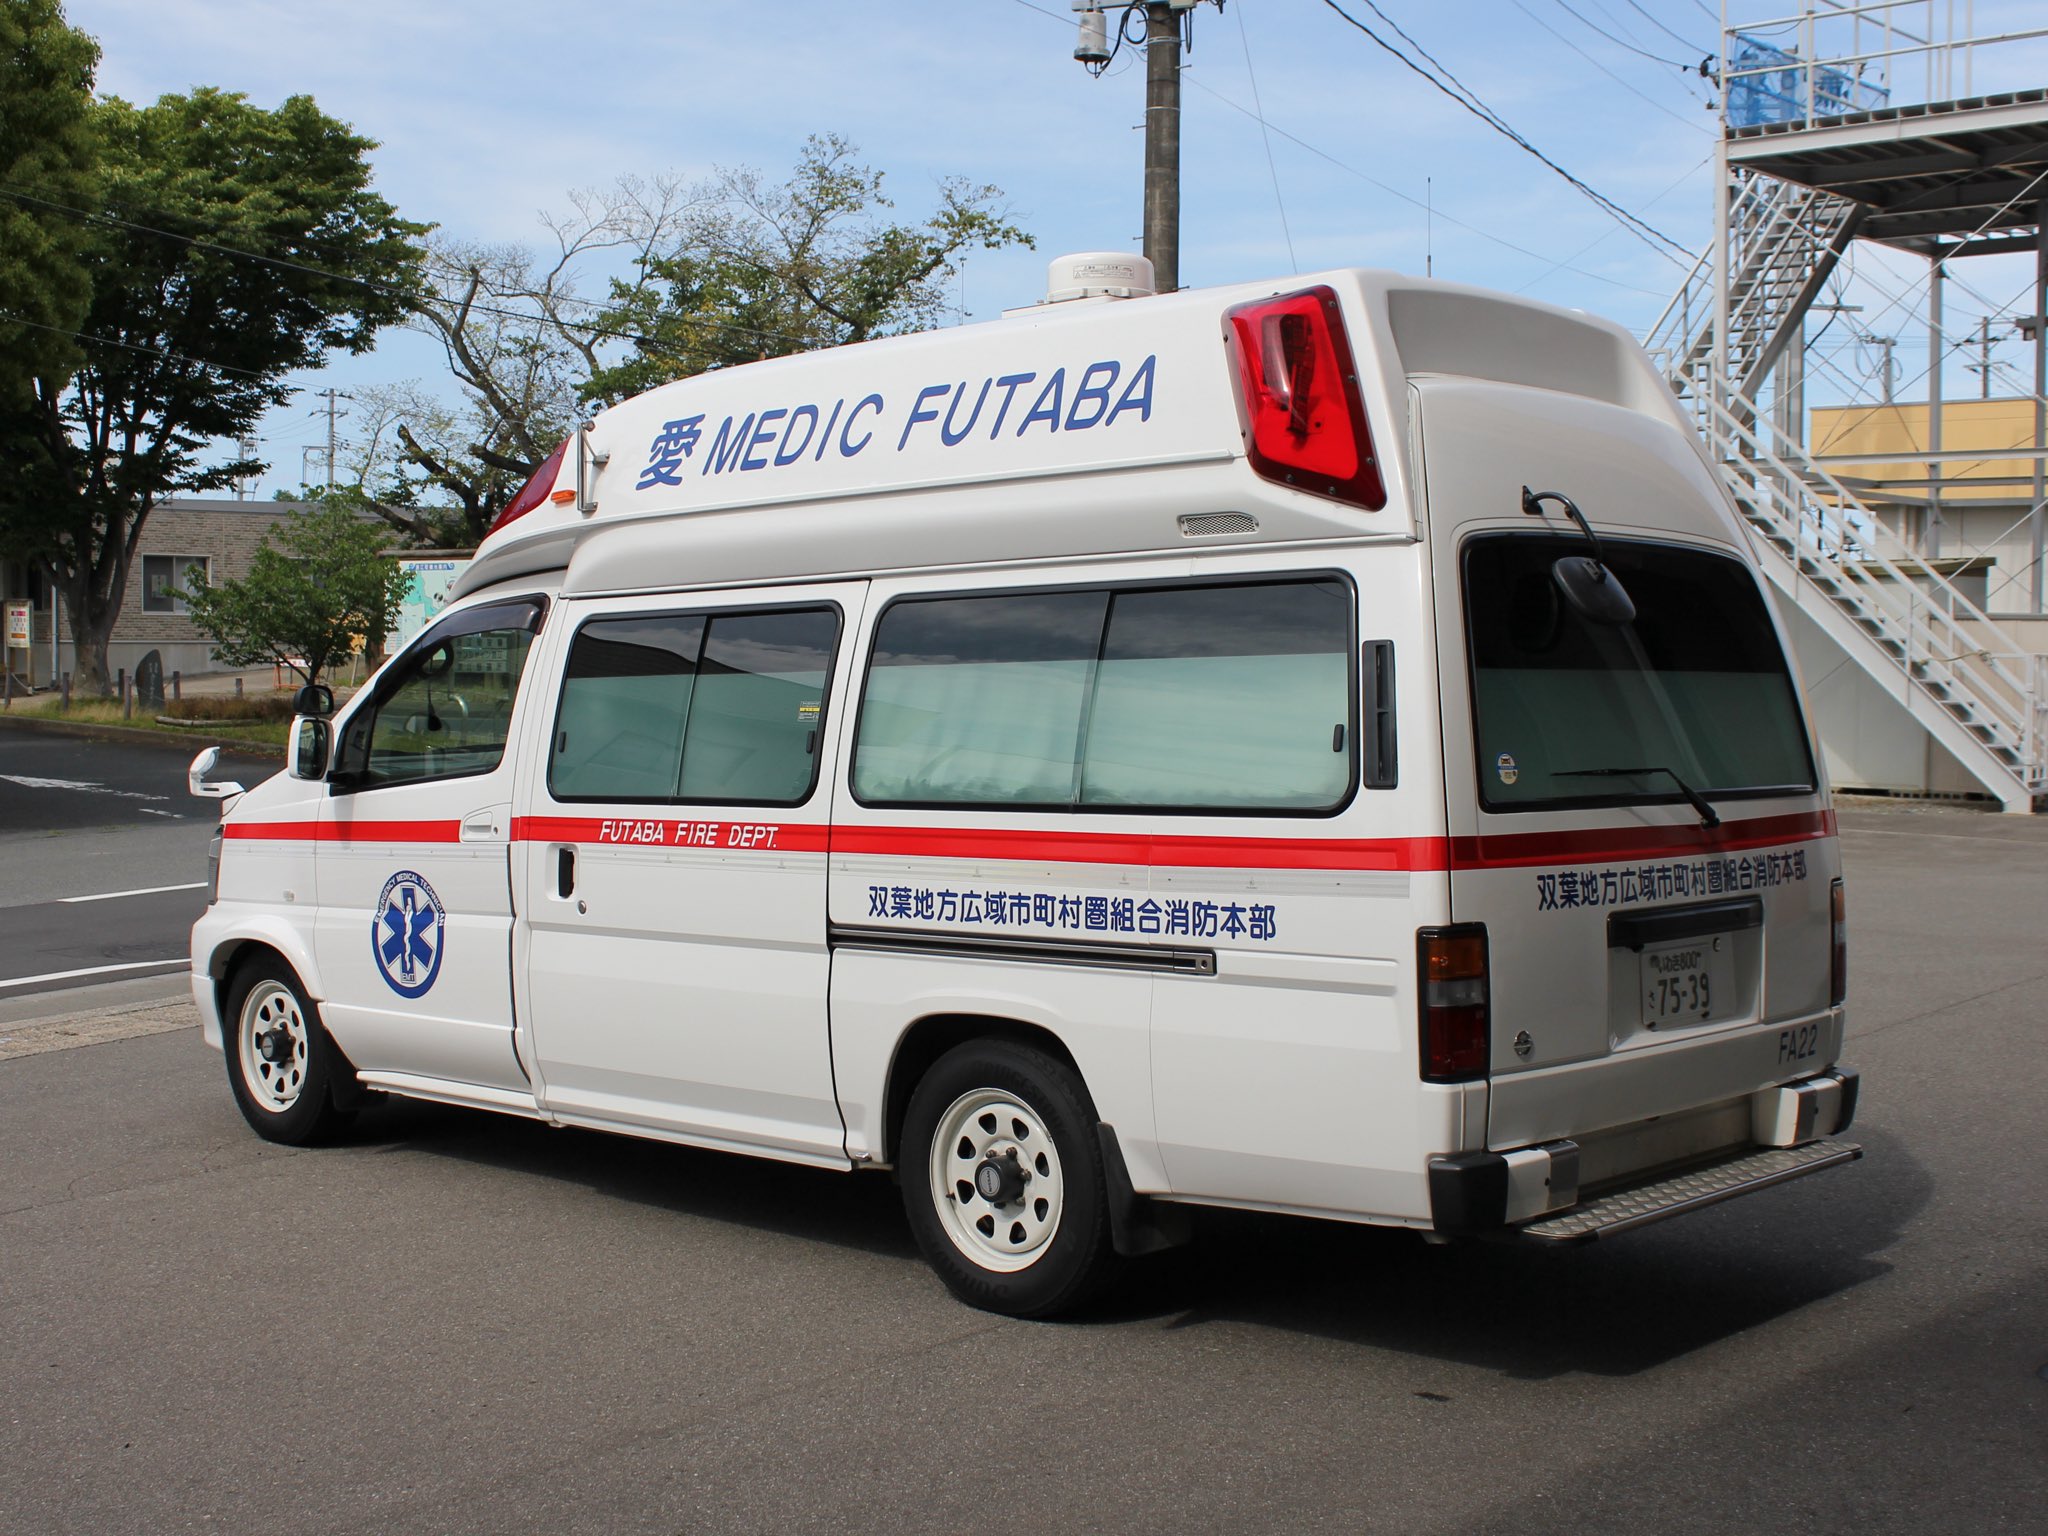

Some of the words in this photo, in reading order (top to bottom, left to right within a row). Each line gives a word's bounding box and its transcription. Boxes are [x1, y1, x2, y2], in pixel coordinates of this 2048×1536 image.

[635, 413, 706, 491] 愛
[702, 393, 884, 476] MEDIC
[897, 354, 1158, 452] FUTABA
[599, 821, 664, 843] FUTABA
[674, 823, 719, 845] FIRE
[727, 826, 779, 848] DEPT.
[396, 873, 419, 884] MEDICAL
[420, 879, 446, 927] TECHNICIAN
[1536, 849, 1807, 912] 双葉地方広域市町村圏組合消防本部
[868, 885, 1277, 941] 双葉地方広域市町村圏組合消防本部
[1657, 972, 1710, 1016] 75-39
[1777, 1023, 1818, 1065] FA22
